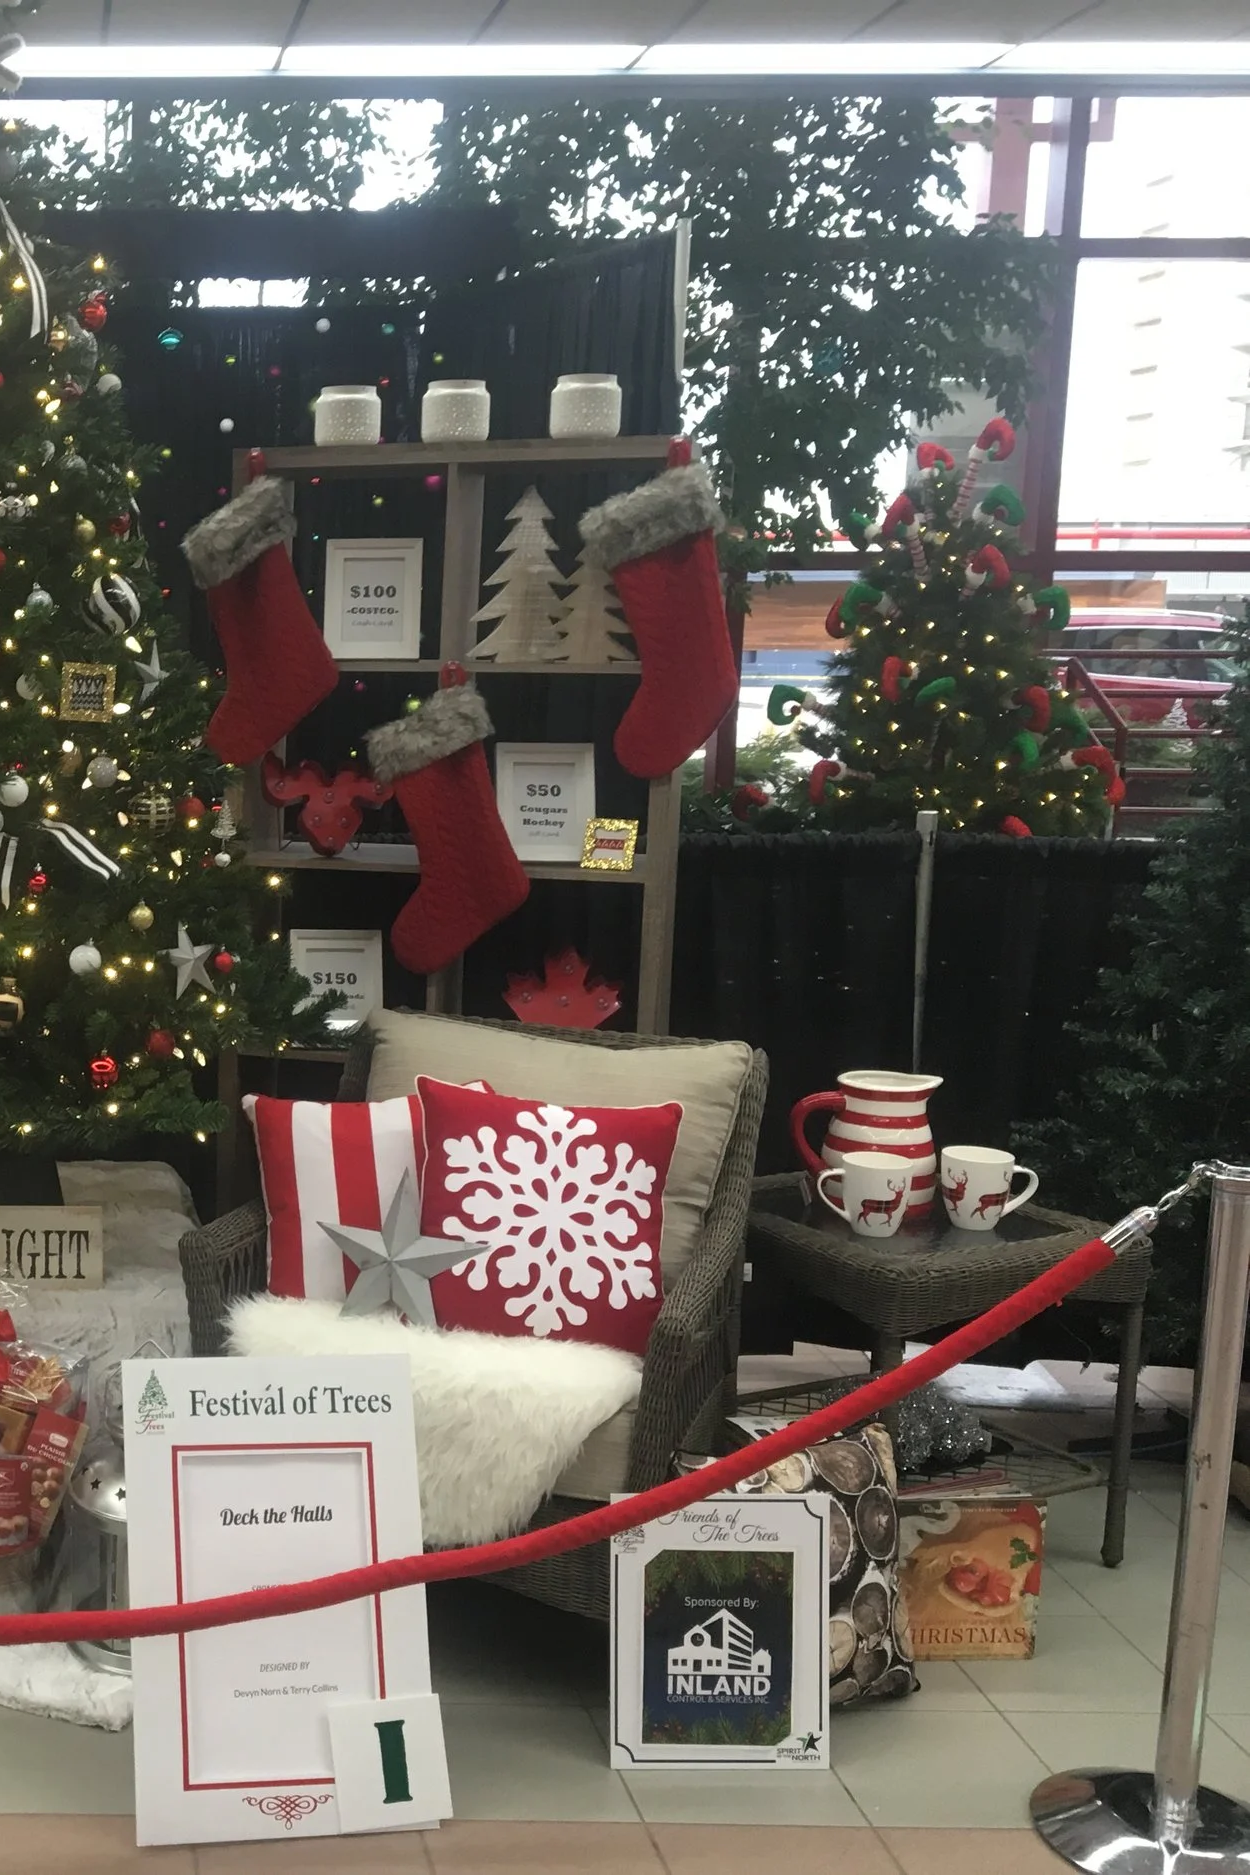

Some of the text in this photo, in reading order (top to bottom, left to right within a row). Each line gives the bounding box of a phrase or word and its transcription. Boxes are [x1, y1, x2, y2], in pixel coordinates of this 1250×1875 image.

[350, 585, 397, 599] $100
[526, 784, 561, 797] $50
[520, 805, 568, 815] Cougars
[522, 818, 565, 828] Hockey
[313, 972, 358, 985] $150
[292, 1386, 318, 1414] of
[323, 1386, 392, 1414] Trees
[220, 1504, 333, 1527] Deck the Halls
[658, 1508, 741, 1529] Friends of
[693, 1524, 779, 1543] The Trees
[684, 1597, 760, 1608] Sponsored By:
[910, 1626, 1027, 1645] HRISTMAS
[259, 1661, 310, 1672] DESIGNED BY
[234, 1690, 259, 1699] Devyn
[282, 1686, 288, 1695] &
[290, 1685, 310, 1695] Terry
[312, 1683, 338, 1693] Collins
[667, 1675, 771, 1696] INLAND
[667, 1696, 706, 1704] CONTROL
[715, 1696, 753, 1704] SERVICES
